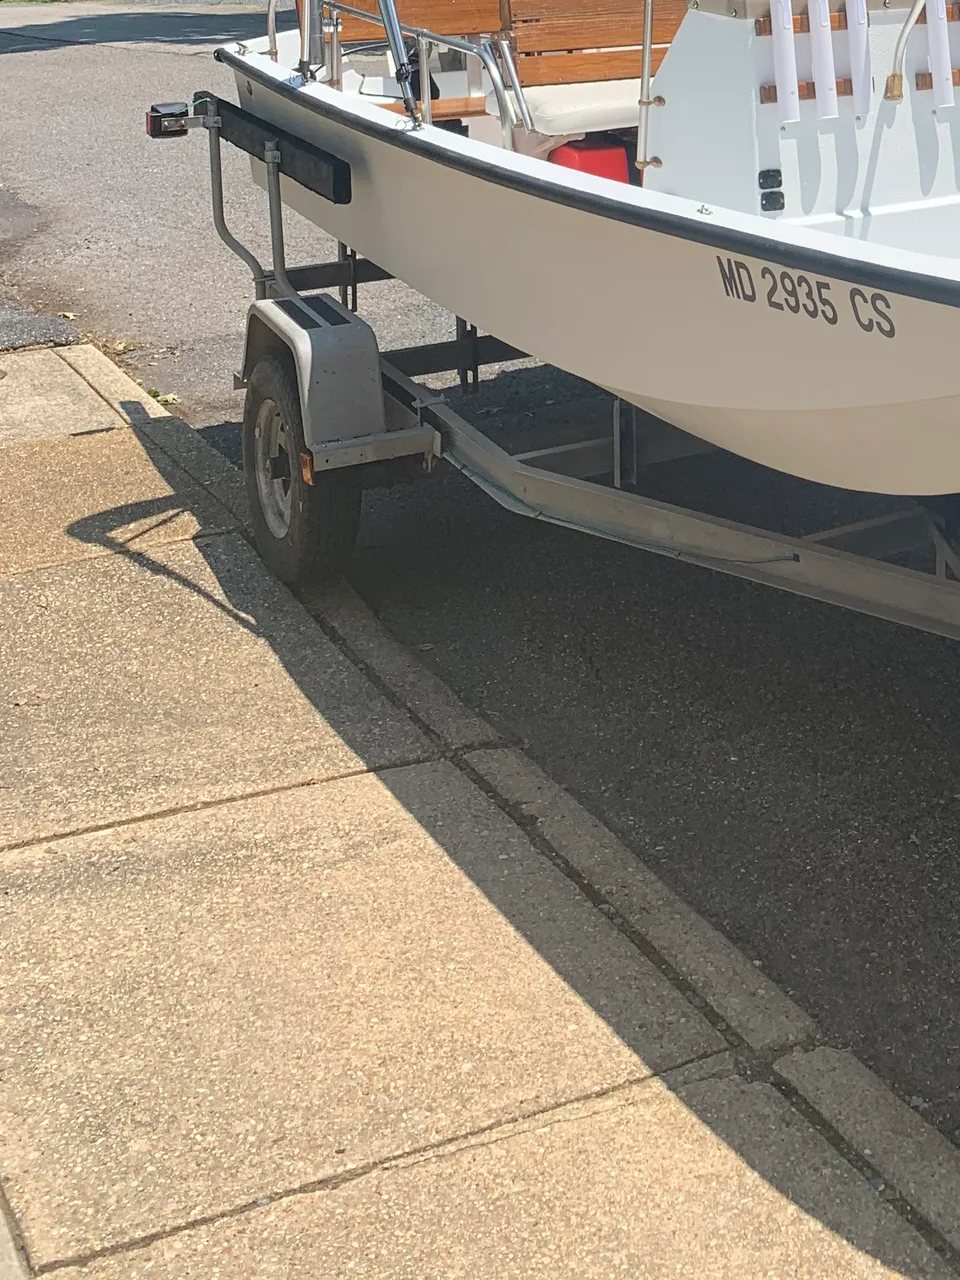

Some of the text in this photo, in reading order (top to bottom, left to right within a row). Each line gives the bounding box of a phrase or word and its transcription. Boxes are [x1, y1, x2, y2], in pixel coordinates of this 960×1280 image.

[716, 255, 896, 339] MD 2935 CS
